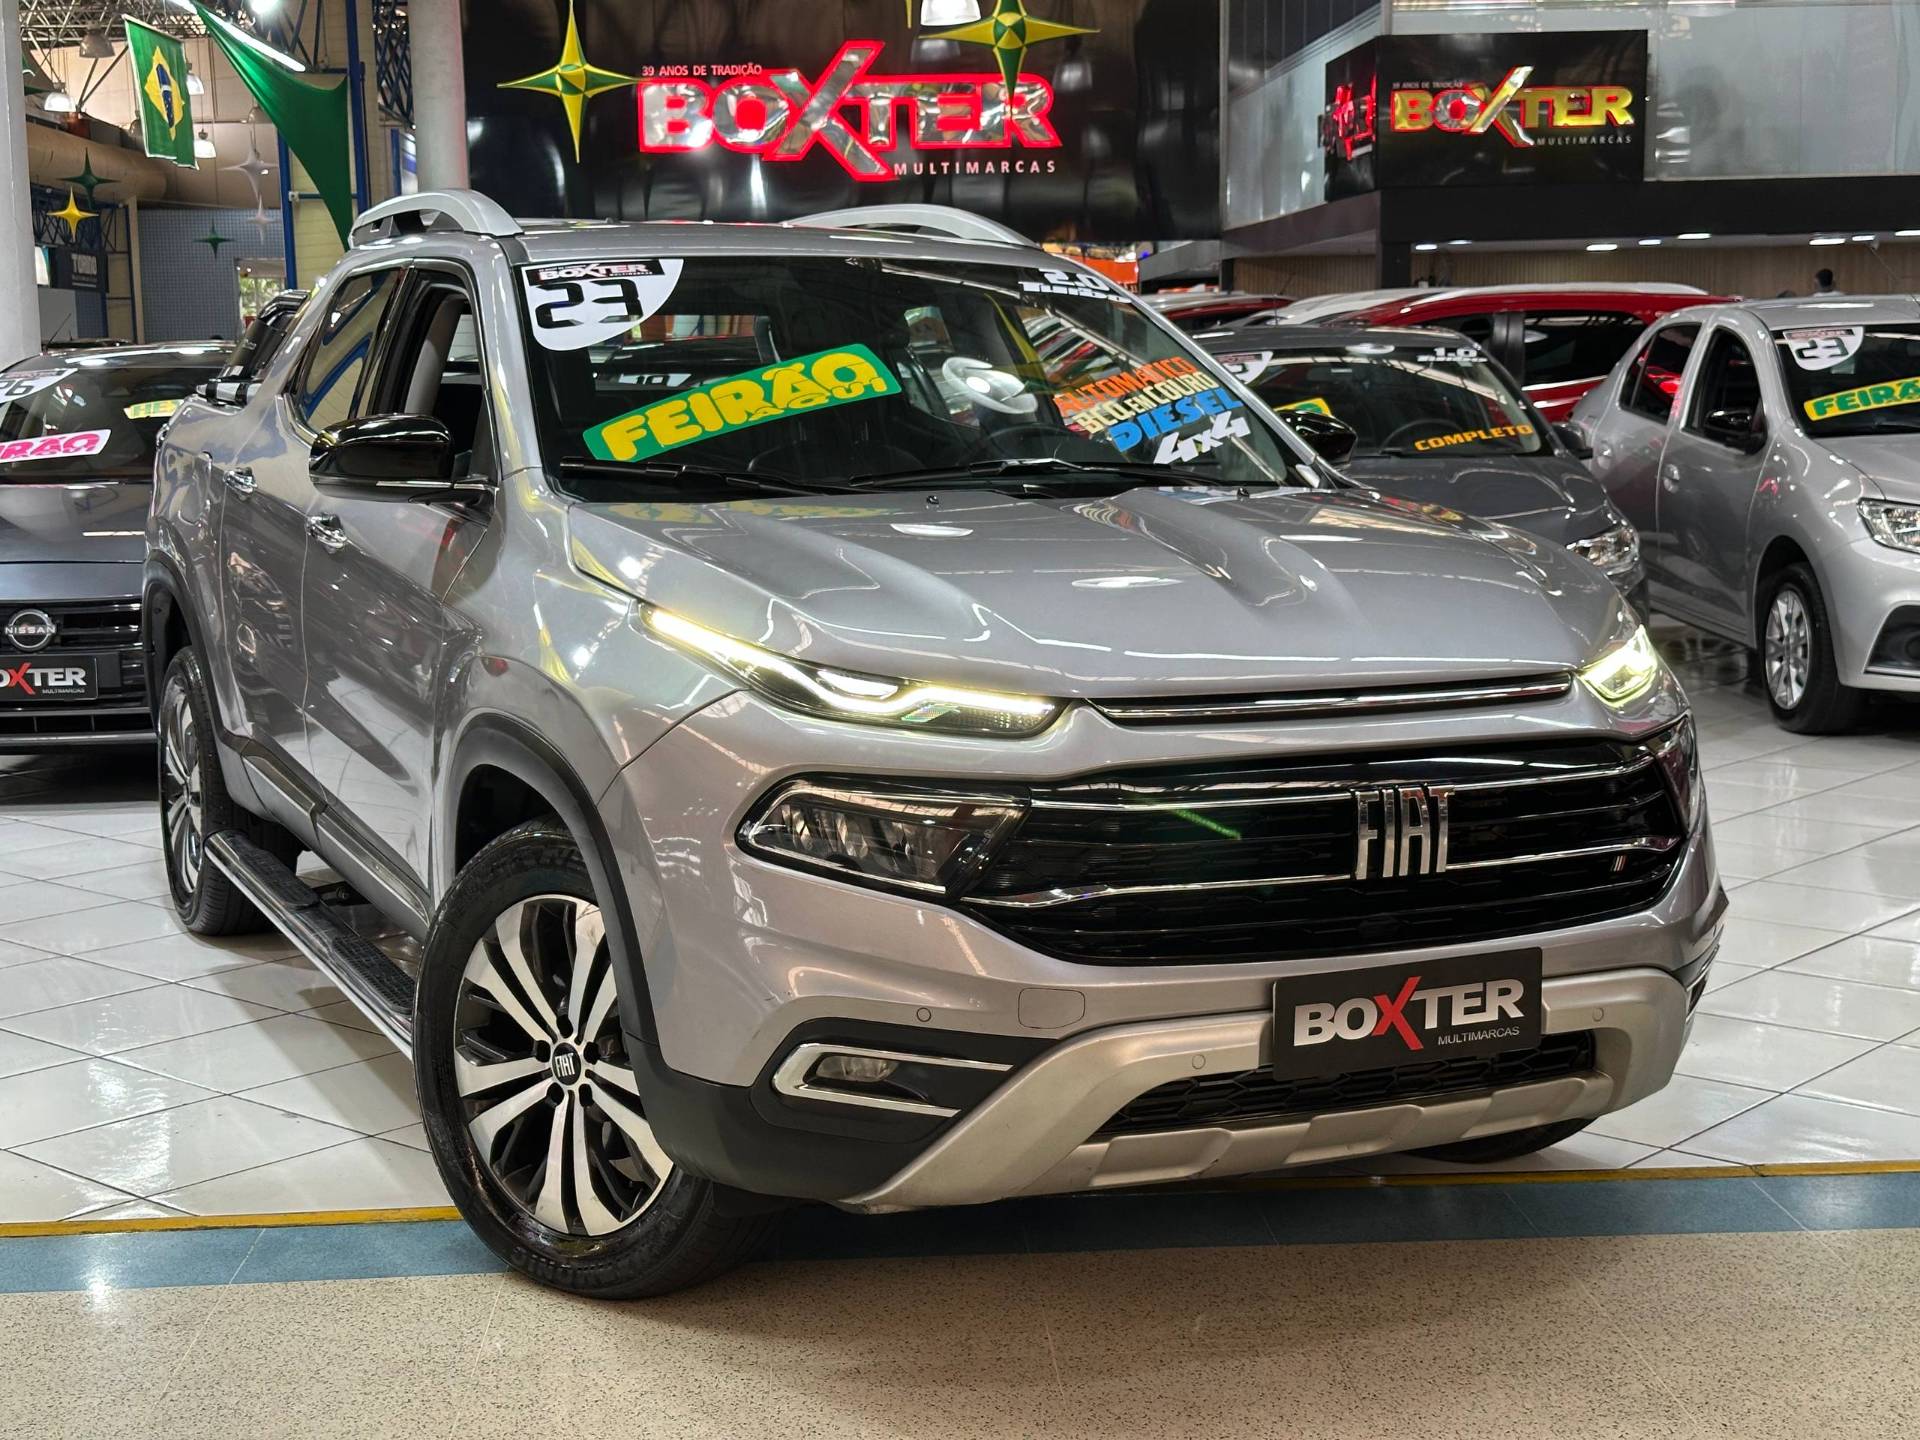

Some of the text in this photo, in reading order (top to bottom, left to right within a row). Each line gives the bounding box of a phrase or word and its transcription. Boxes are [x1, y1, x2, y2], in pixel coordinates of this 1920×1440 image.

[642, 61, 762, 76] 39 ANOS DE TRADIÇÃO
[638, 40, 1062, 181] BOXTER
[1390, 64, 1635, 147] BOXTER
[1535, 135, 1632, 146] MULTIMARCAS
[893, 160, 1057, 176] MULTIMARCAS
[538, 263, 649, 281] BOXTER
[1039, 268, 1110, 291] 2.0
[534, 278, 643, 329] 23
[601, 352, 885, 461] FEIRÃO
[1108, 387, 1244, 453] DIESEL
[1414, 424, 1533, 450] COMPLETO
[5, 626, 56, 634] NISSAN
[1354, 786, 1455, 880] FIAT
[1293, 976, 1525, 1050] BOXTER
[1437, 1025, 1520, 1046] MULTIMARCAS
[554, 1052, 576, 1078] FIAT
